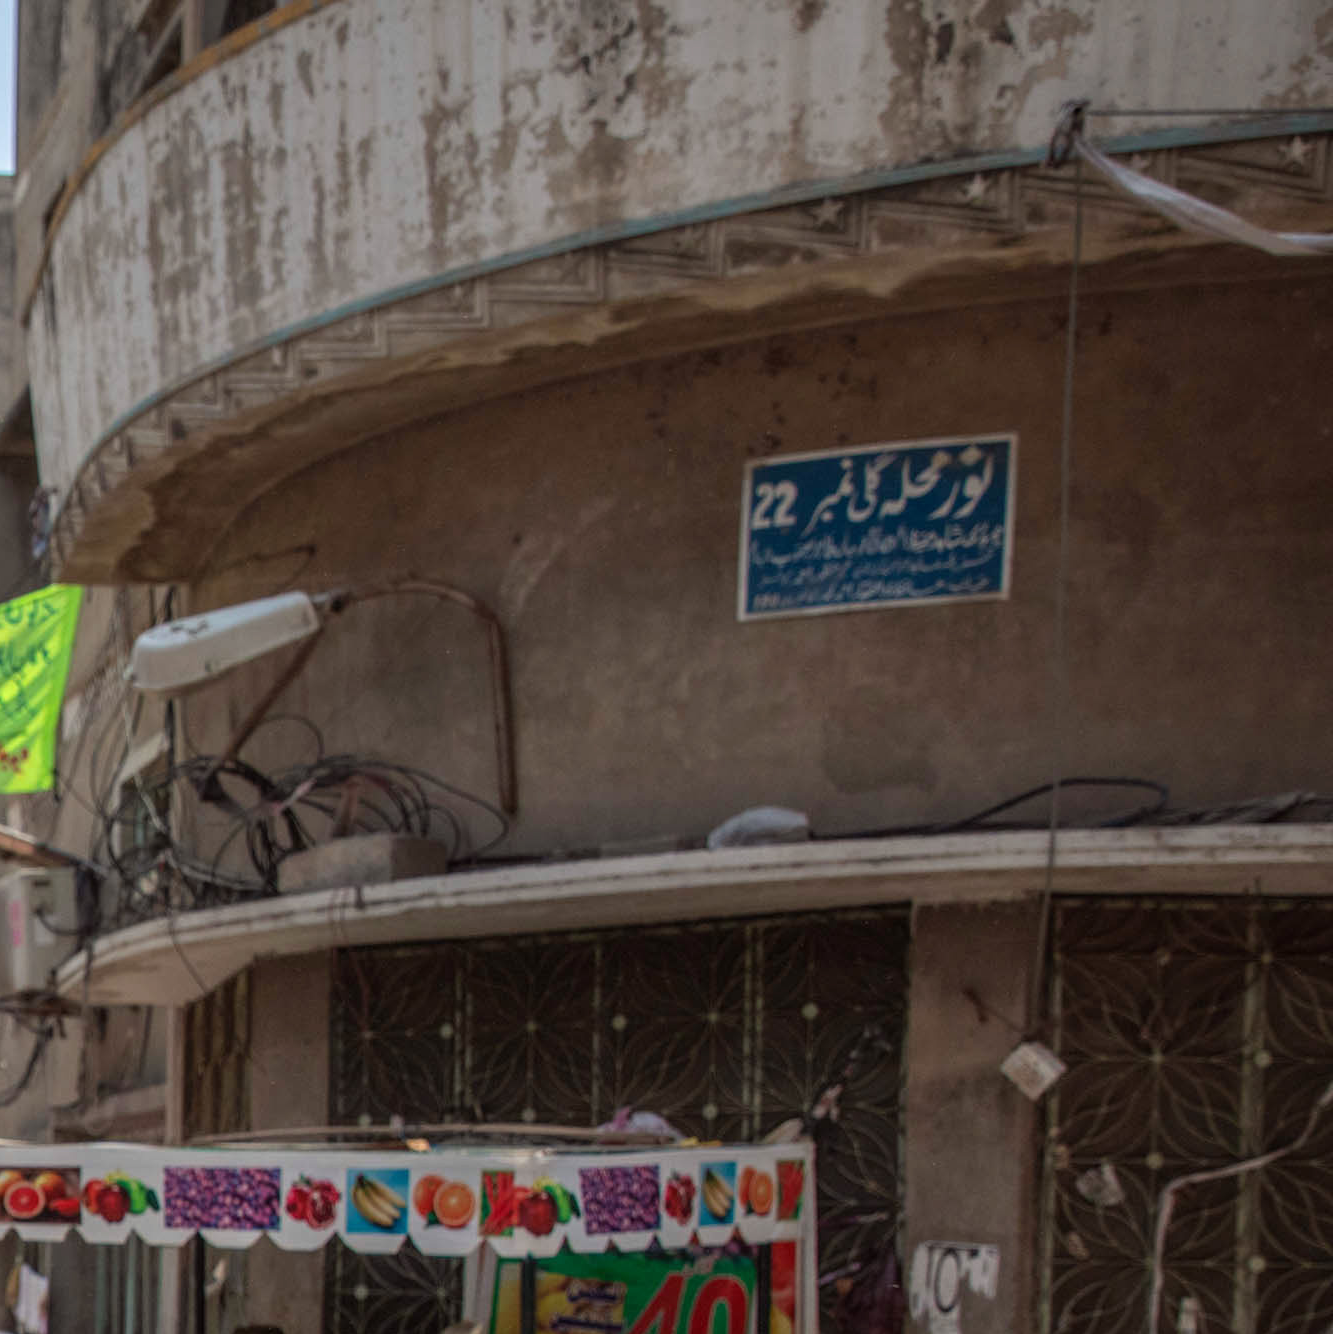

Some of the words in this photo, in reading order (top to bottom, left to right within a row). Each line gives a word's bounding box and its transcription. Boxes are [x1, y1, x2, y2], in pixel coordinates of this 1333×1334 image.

[751, 480, 799, 529] 22
[800, 457, 854, 538] نمبر
[846, 453, 898, 524] گلی
[929, 445, 994, 521] نور
